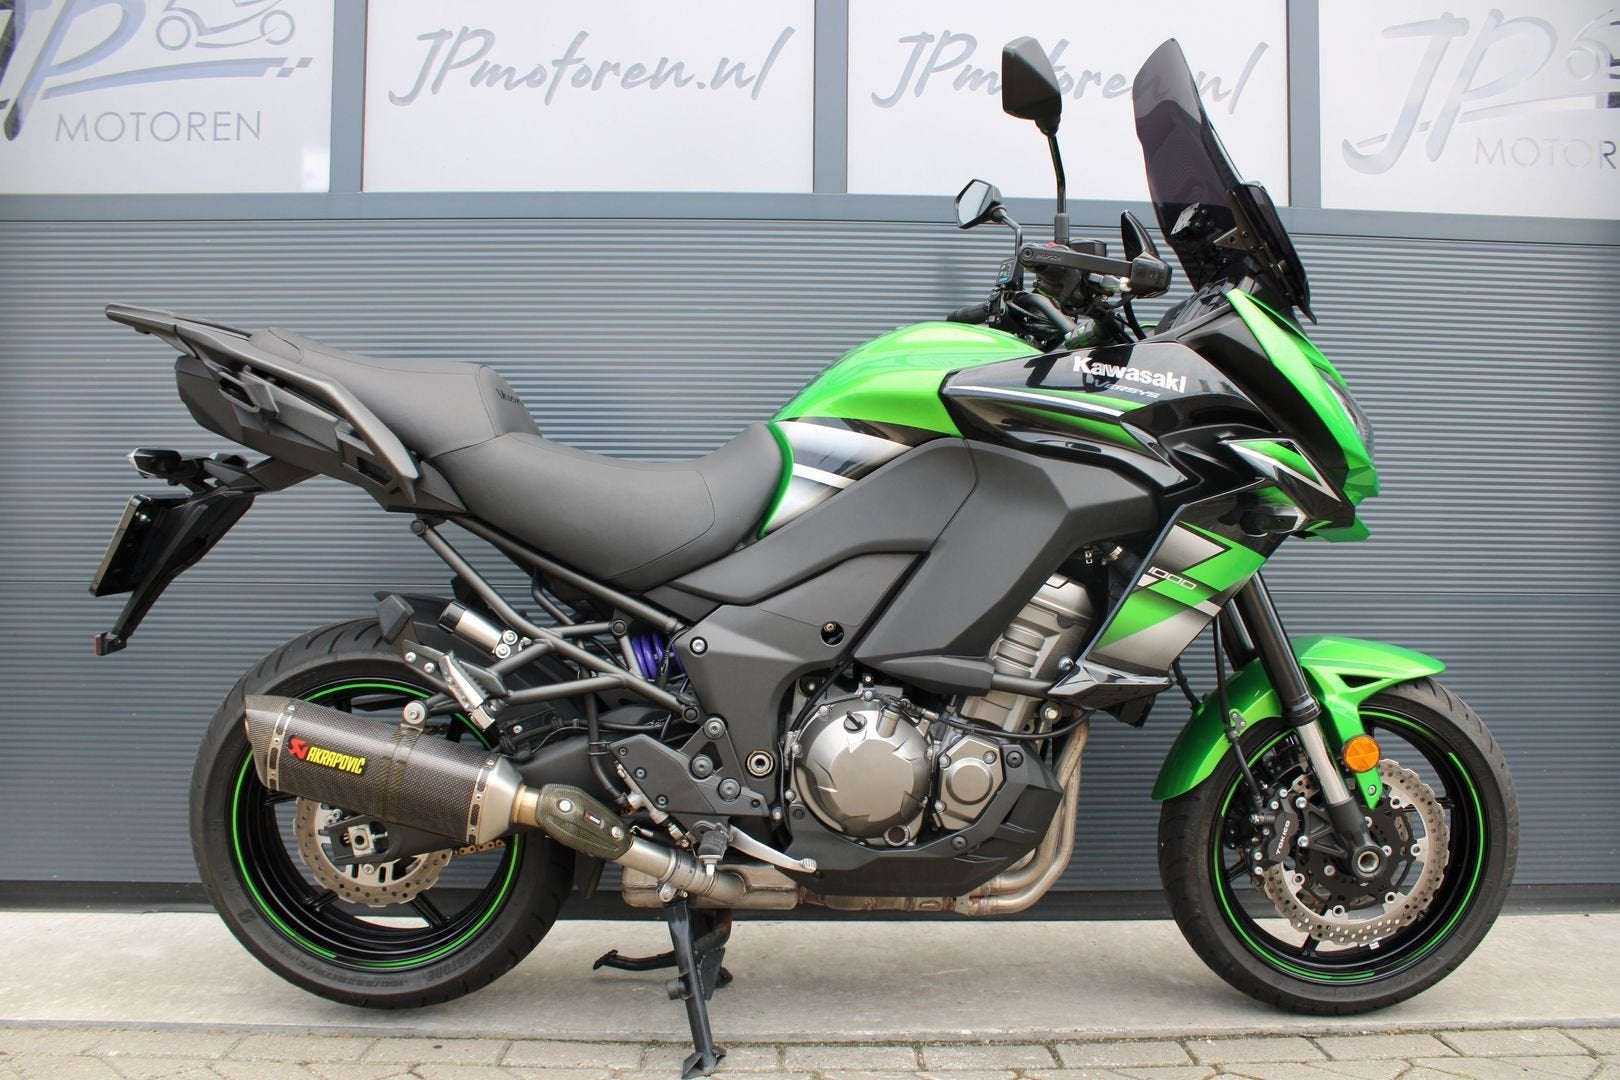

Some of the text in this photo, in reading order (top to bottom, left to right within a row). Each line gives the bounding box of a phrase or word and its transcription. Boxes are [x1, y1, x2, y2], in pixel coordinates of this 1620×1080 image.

[389, 27, 796, 106] JPmotoren.nl
[871, 30, 1269, 115] JPmorennl
[55, 111, 261, 142] MOTOREN
[1073, 356, 1187, 394] Kawasaki
[1148, 566, 1197, 591] 1000
[1275, 820, 1291, 855] TOKICO
